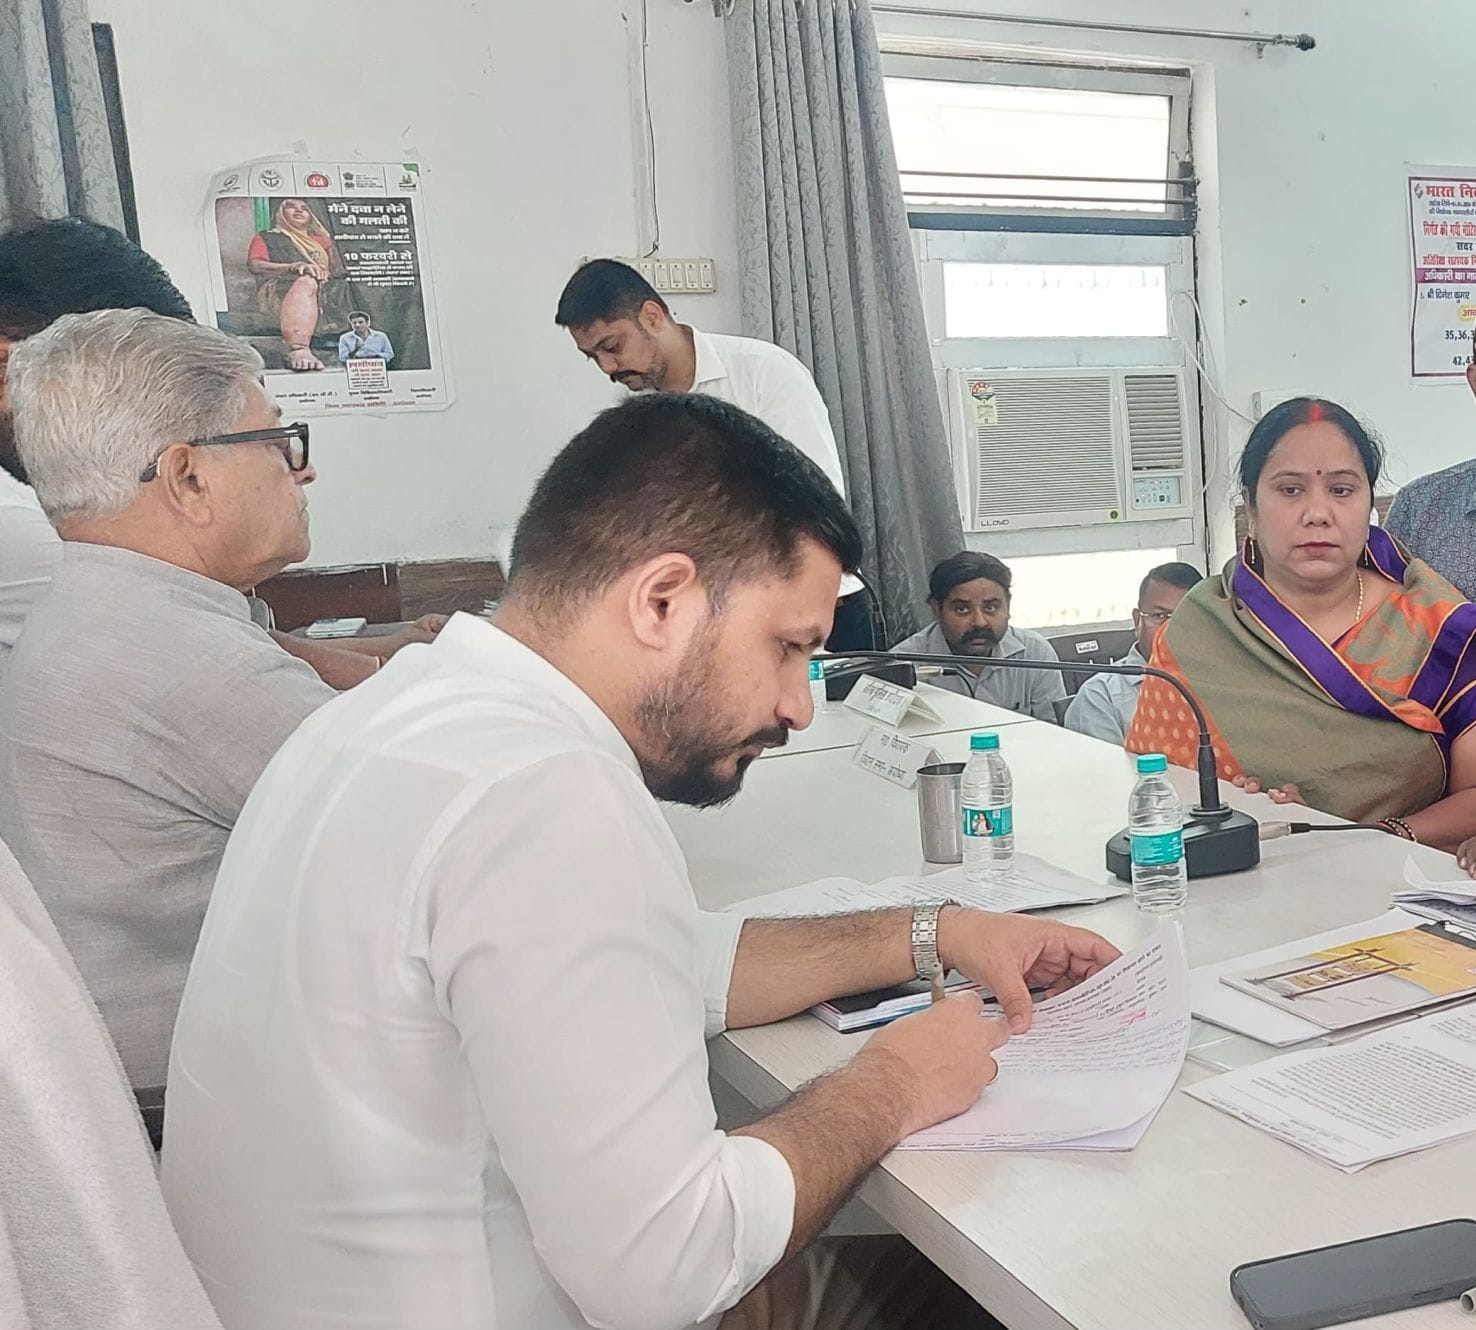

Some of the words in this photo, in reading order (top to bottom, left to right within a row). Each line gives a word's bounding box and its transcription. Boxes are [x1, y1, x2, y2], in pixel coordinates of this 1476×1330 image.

[1425, 185, 1455, 198] भारत
[328, 203, 348, 213] मैंने
[350, 205, 372, 214] दवा
[373, 205, 384, 213] न
[386, 203, 407, 213] लेने
[340, 214, 357, 225] की
[358, 214, 390, 225] गलती
[392, 214, 408, 225] की
[1456, 241, 1473, 250] सदर
[360, 250, 397, 260] फरवरी
[400, 250, 412, 260] से
[1424, 269, 1454, 281] अधिकारी
[1455, 271, 1466, 280] का
[1445, 330, 1475, 341] 35,36,3
